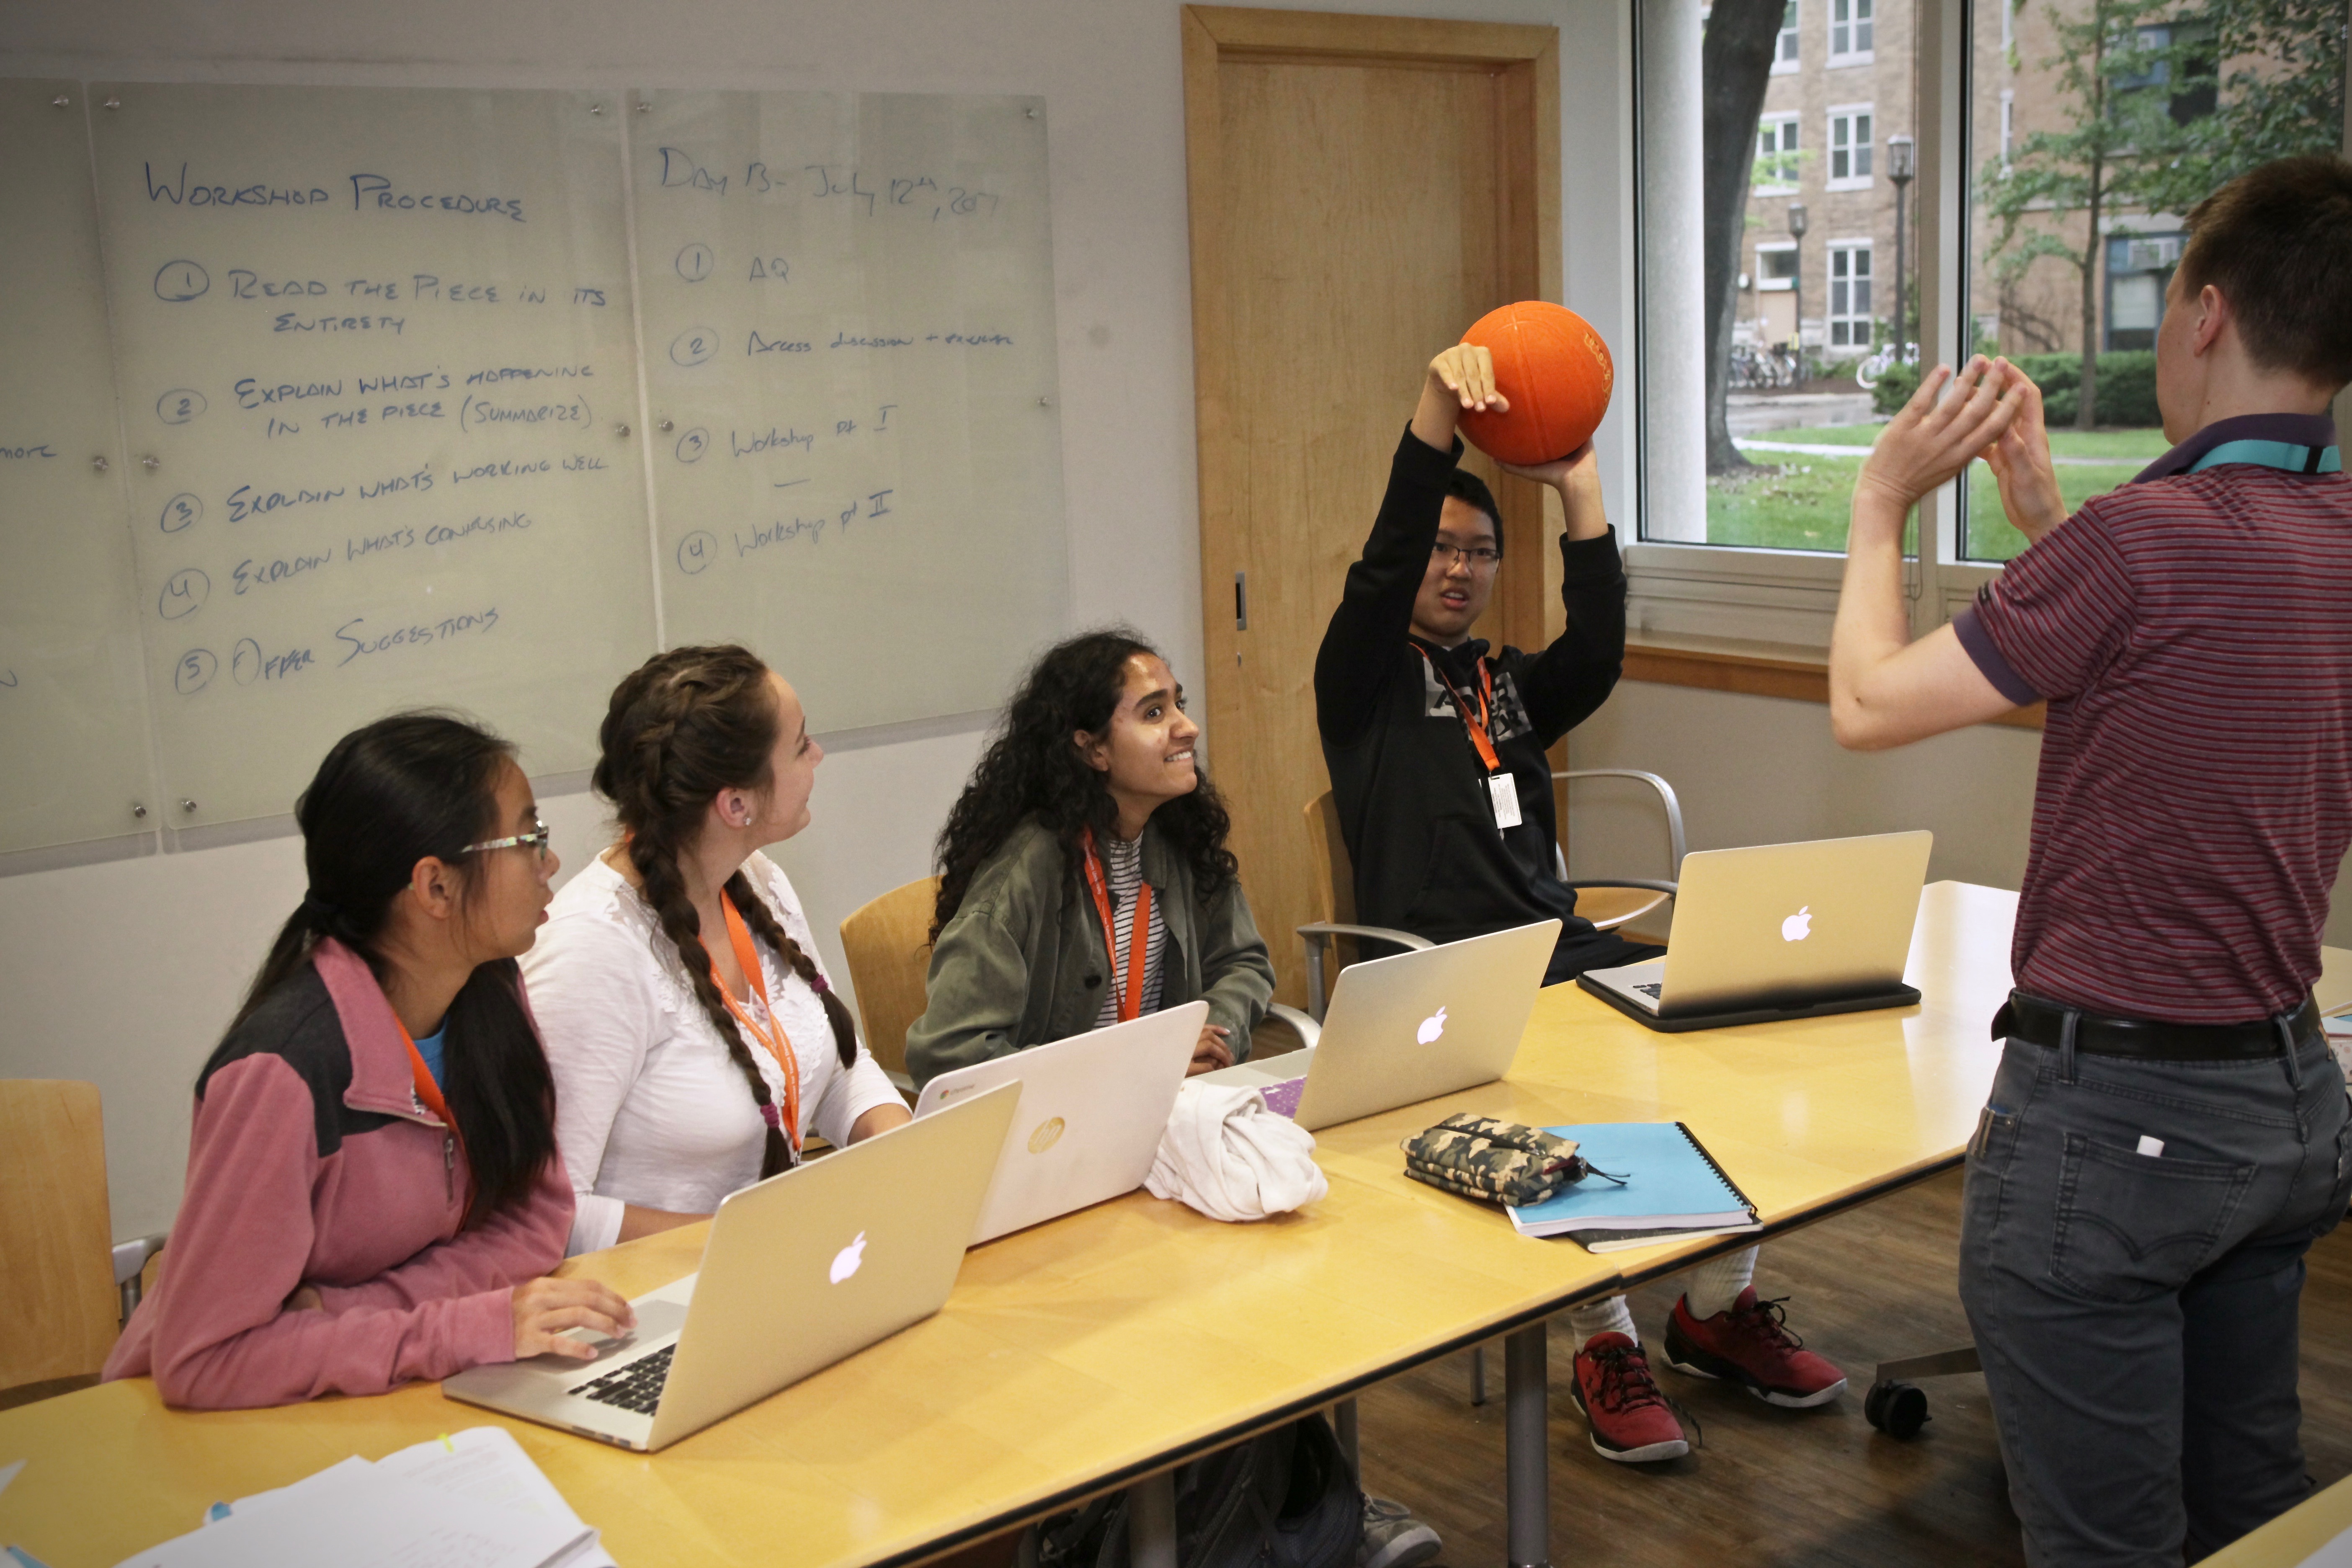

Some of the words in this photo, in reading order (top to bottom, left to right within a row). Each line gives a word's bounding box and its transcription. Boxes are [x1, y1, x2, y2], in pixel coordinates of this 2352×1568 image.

[145, 162, 329, 206] WORKSHOP
[349, 173, 526, 223] PROCEDURE
[228, 269, 327, 299] READ
[346, 279, 398, 300] THE
[574, 288, 606, 307] ITS
[273, 312, 405, 335] ENTIRETY
[234, 378, 342, 410] EXPLAIN
[359, 365, 450, 395] WHAT'S
[321, 408, 367, 428] THE
[226, 485, 345, 524] EXPLAIN
[359, 463, 433, 499] WHAT'S
[453, 461, 550, 484] WORKING
[562, 456, 608, 471] WELL
[232, 549, 331, 596] EXPLAIN
[347, 525, 415, 561] WHAT'S
[335, 607, 499, 667] SUGGESTIONS
